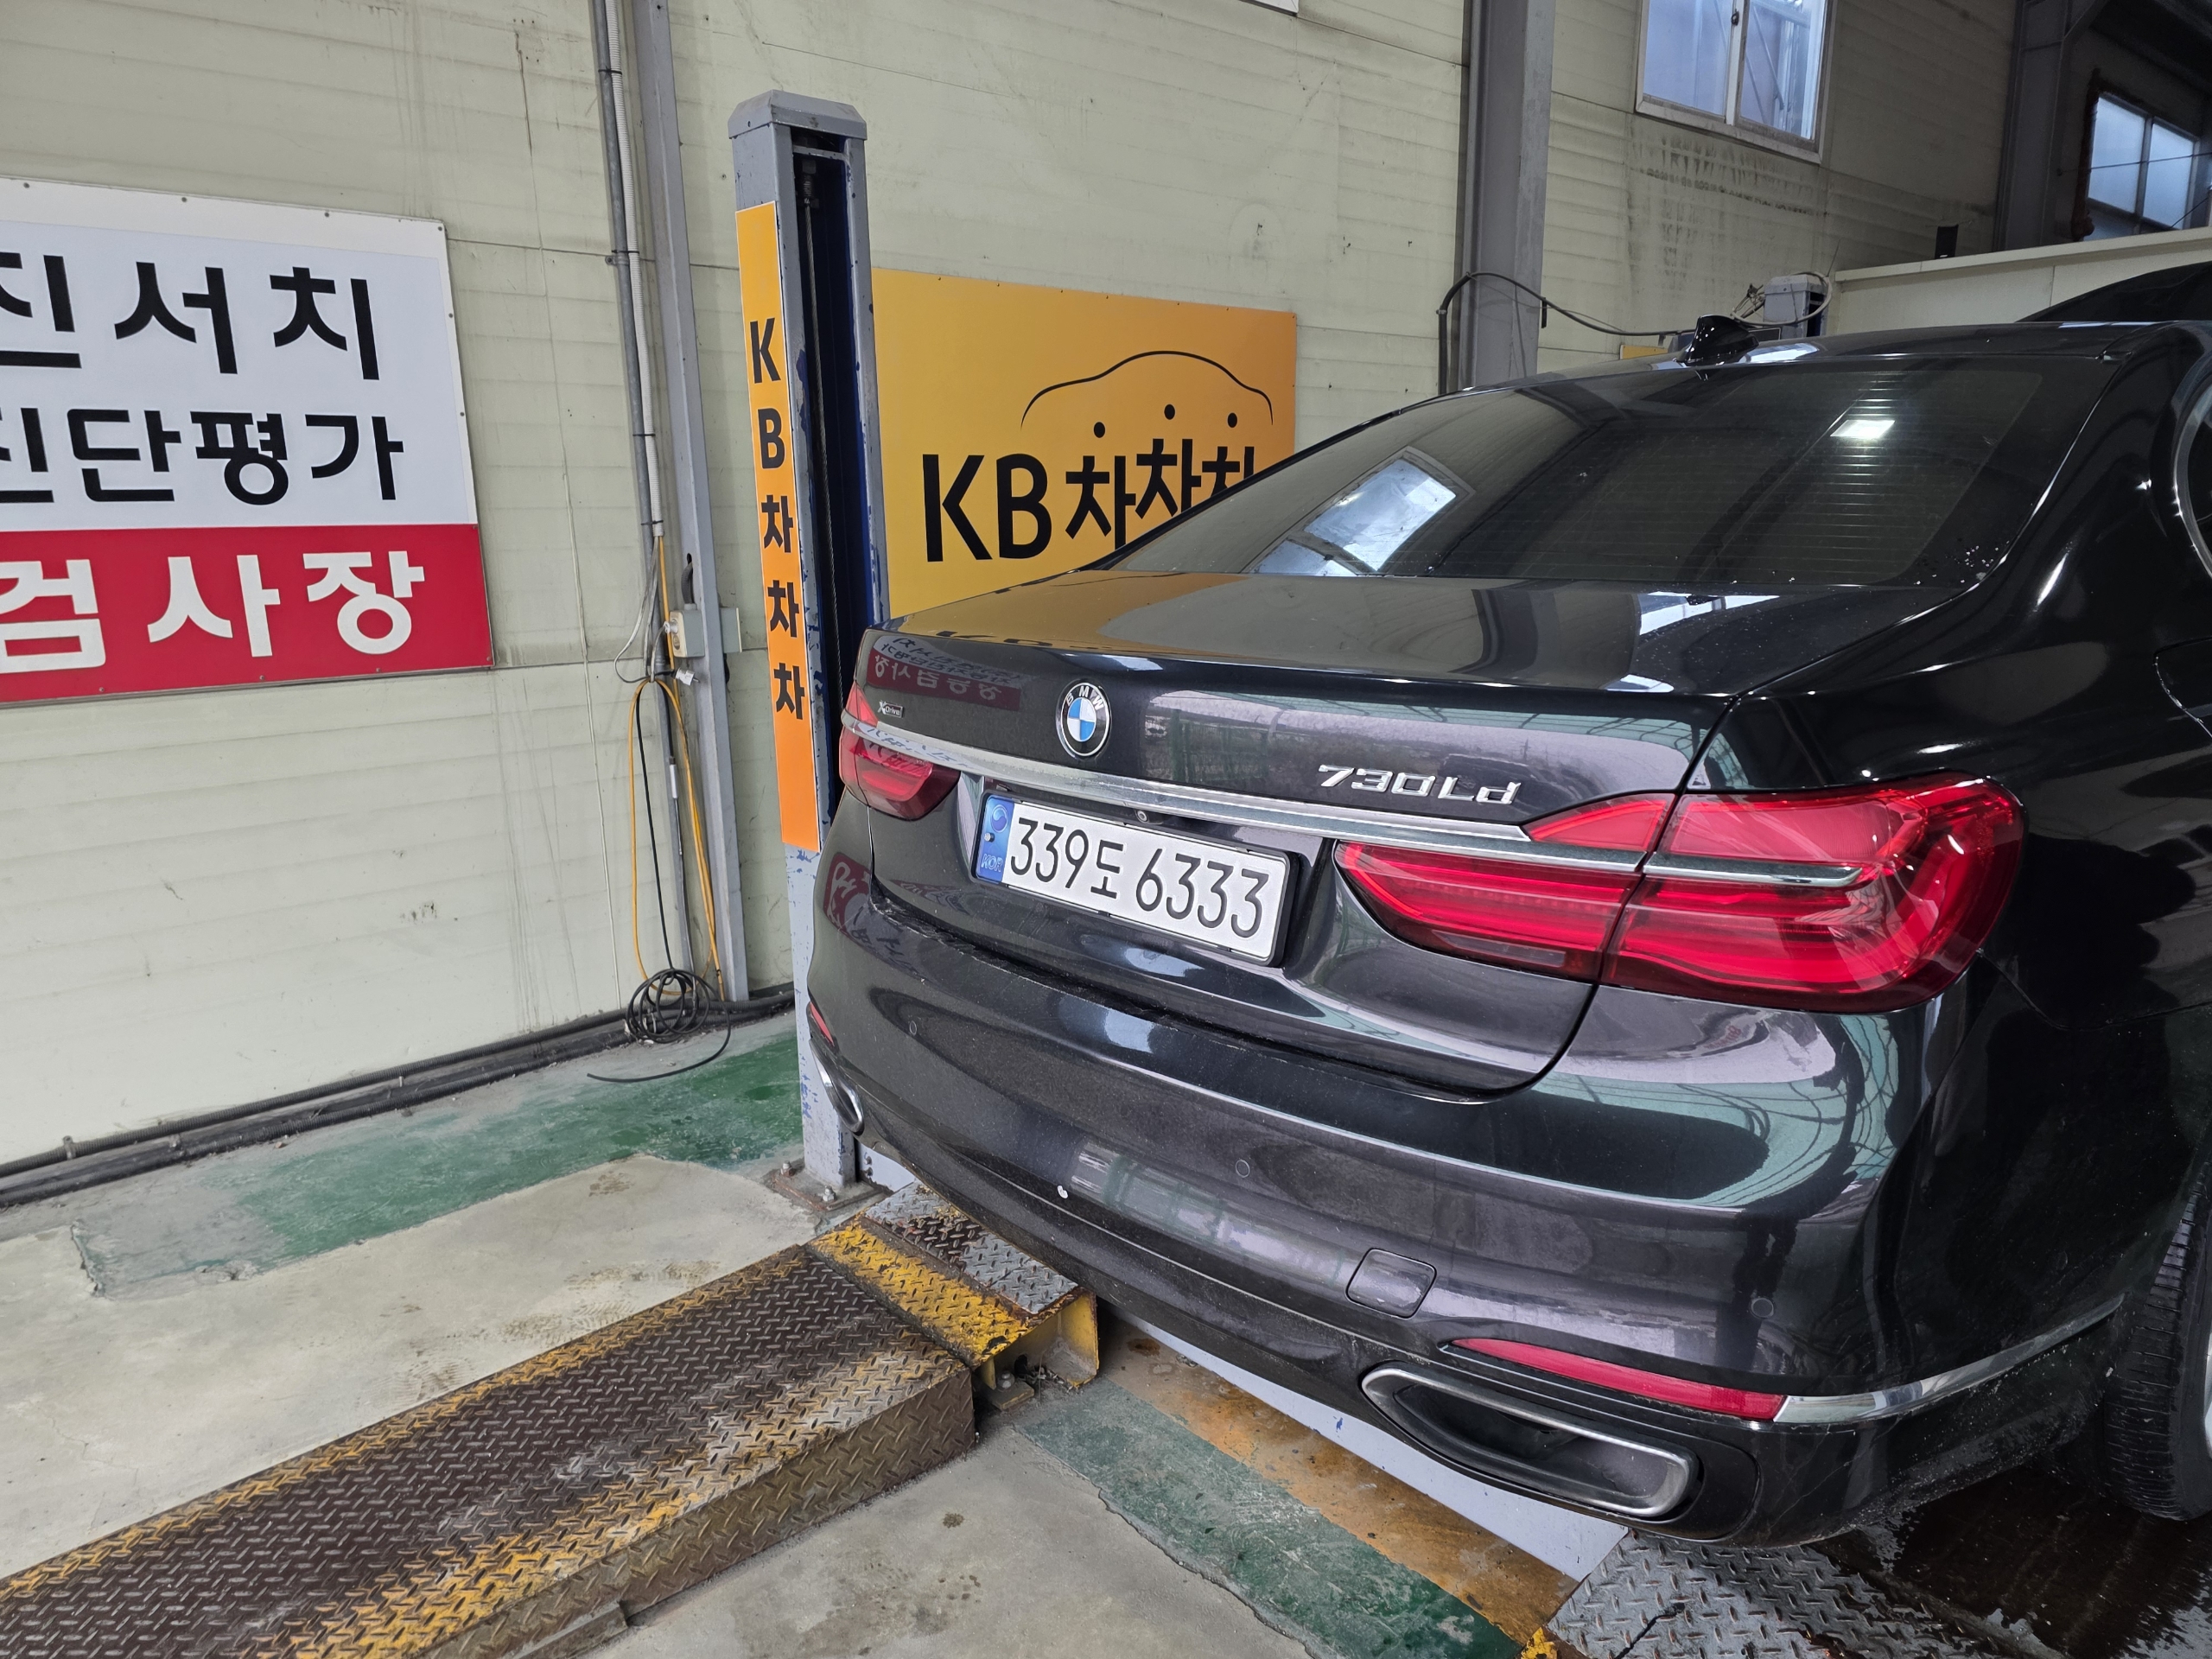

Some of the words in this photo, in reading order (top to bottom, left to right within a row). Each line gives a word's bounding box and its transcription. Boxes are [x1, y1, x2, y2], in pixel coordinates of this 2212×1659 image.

[749, 317, 804, 720] KB차차차
[1065, 685, 1104, 710] BMW
[1319, 764, 1522, 804] 730Ld
[980, 853, 1004, 873] KOR
[1010, 817, 1124, 899] 339도
[1135, 848, 1269, 938] 6333
